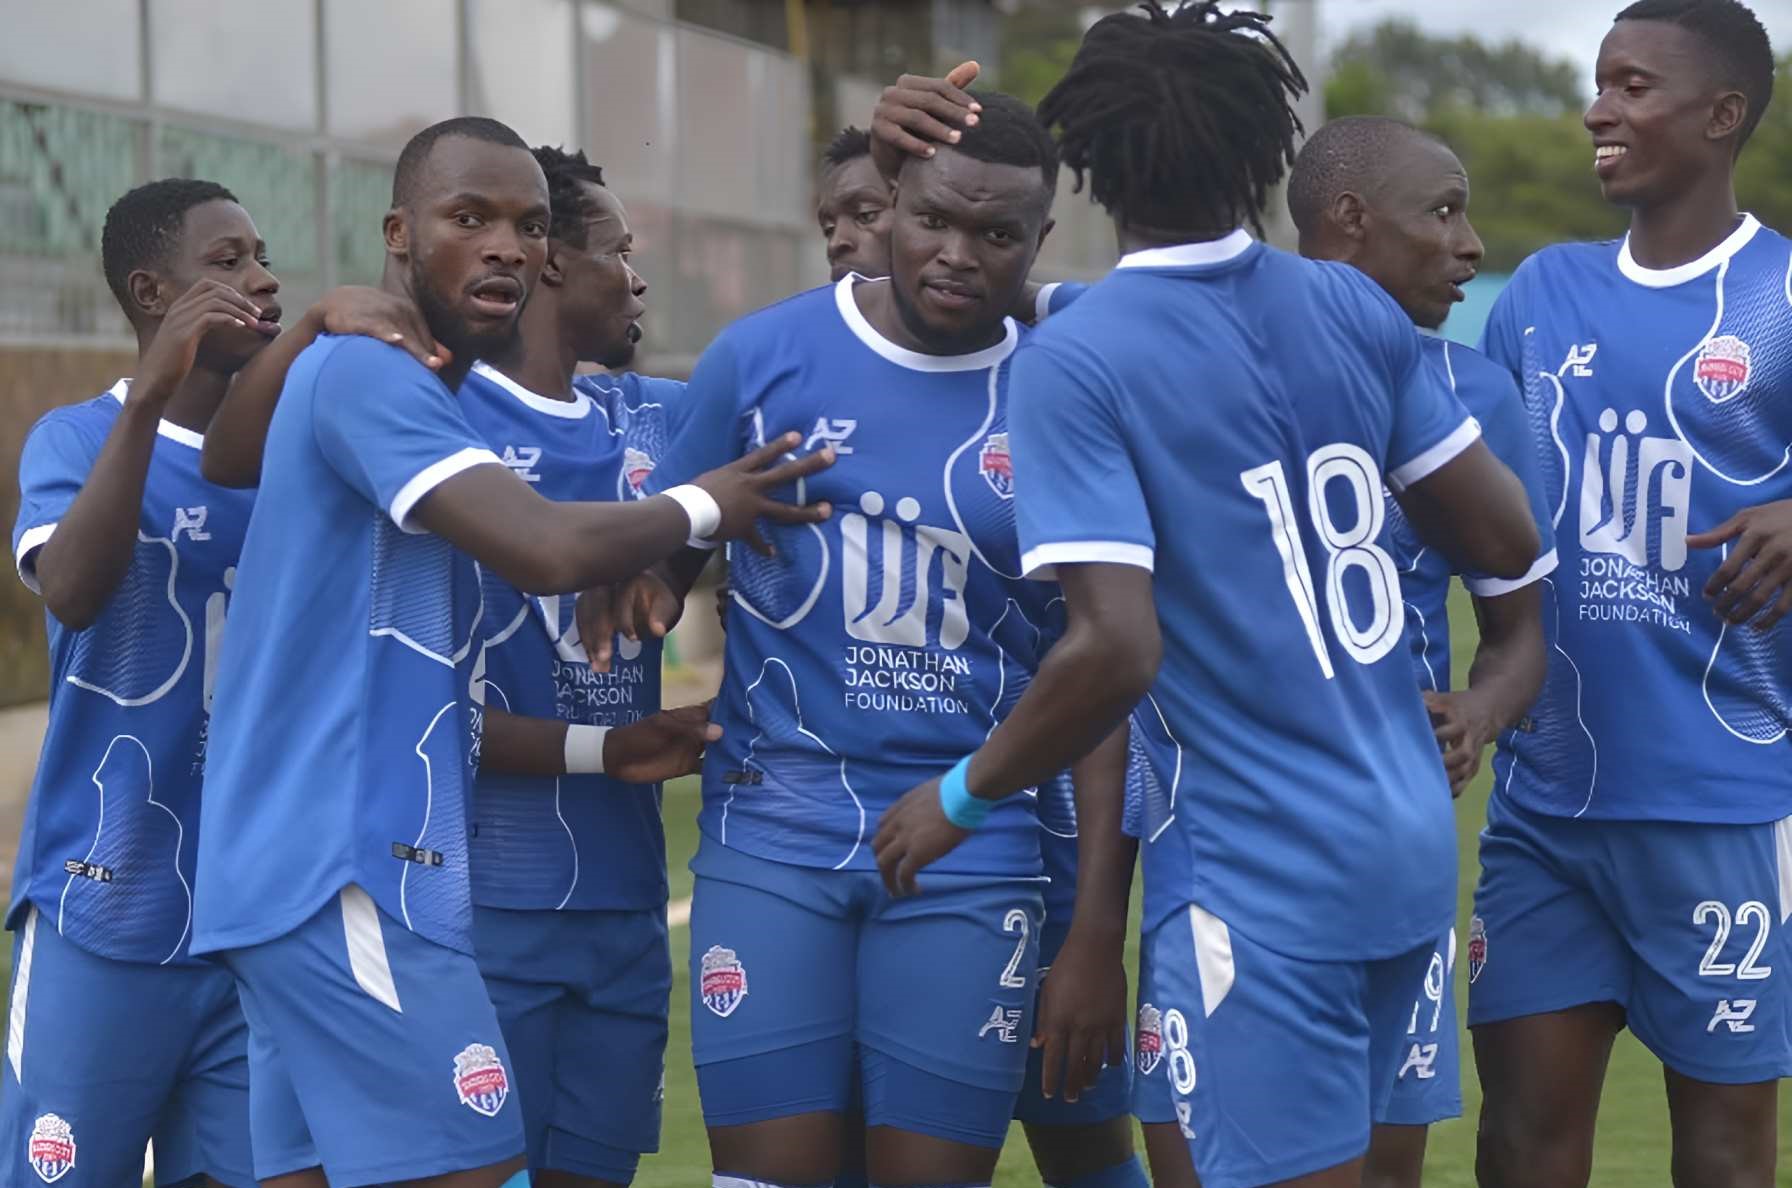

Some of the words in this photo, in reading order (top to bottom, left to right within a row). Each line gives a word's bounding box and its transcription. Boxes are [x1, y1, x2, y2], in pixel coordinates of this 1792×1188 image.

[1240, 442, 1405, 680] 18
[1579, 557, 1689, 597] JONATHAN
[1579, 579, 1675, 614] JACKSON
[845, 647, 971, 675] JONATHAN
[845, 668, 955, 692] JACKSON
[845, 693, 968, 715] FOUNDATION
[1000, 909, 1029, 989] 2
[1693, 900, 1772, 980] 22
